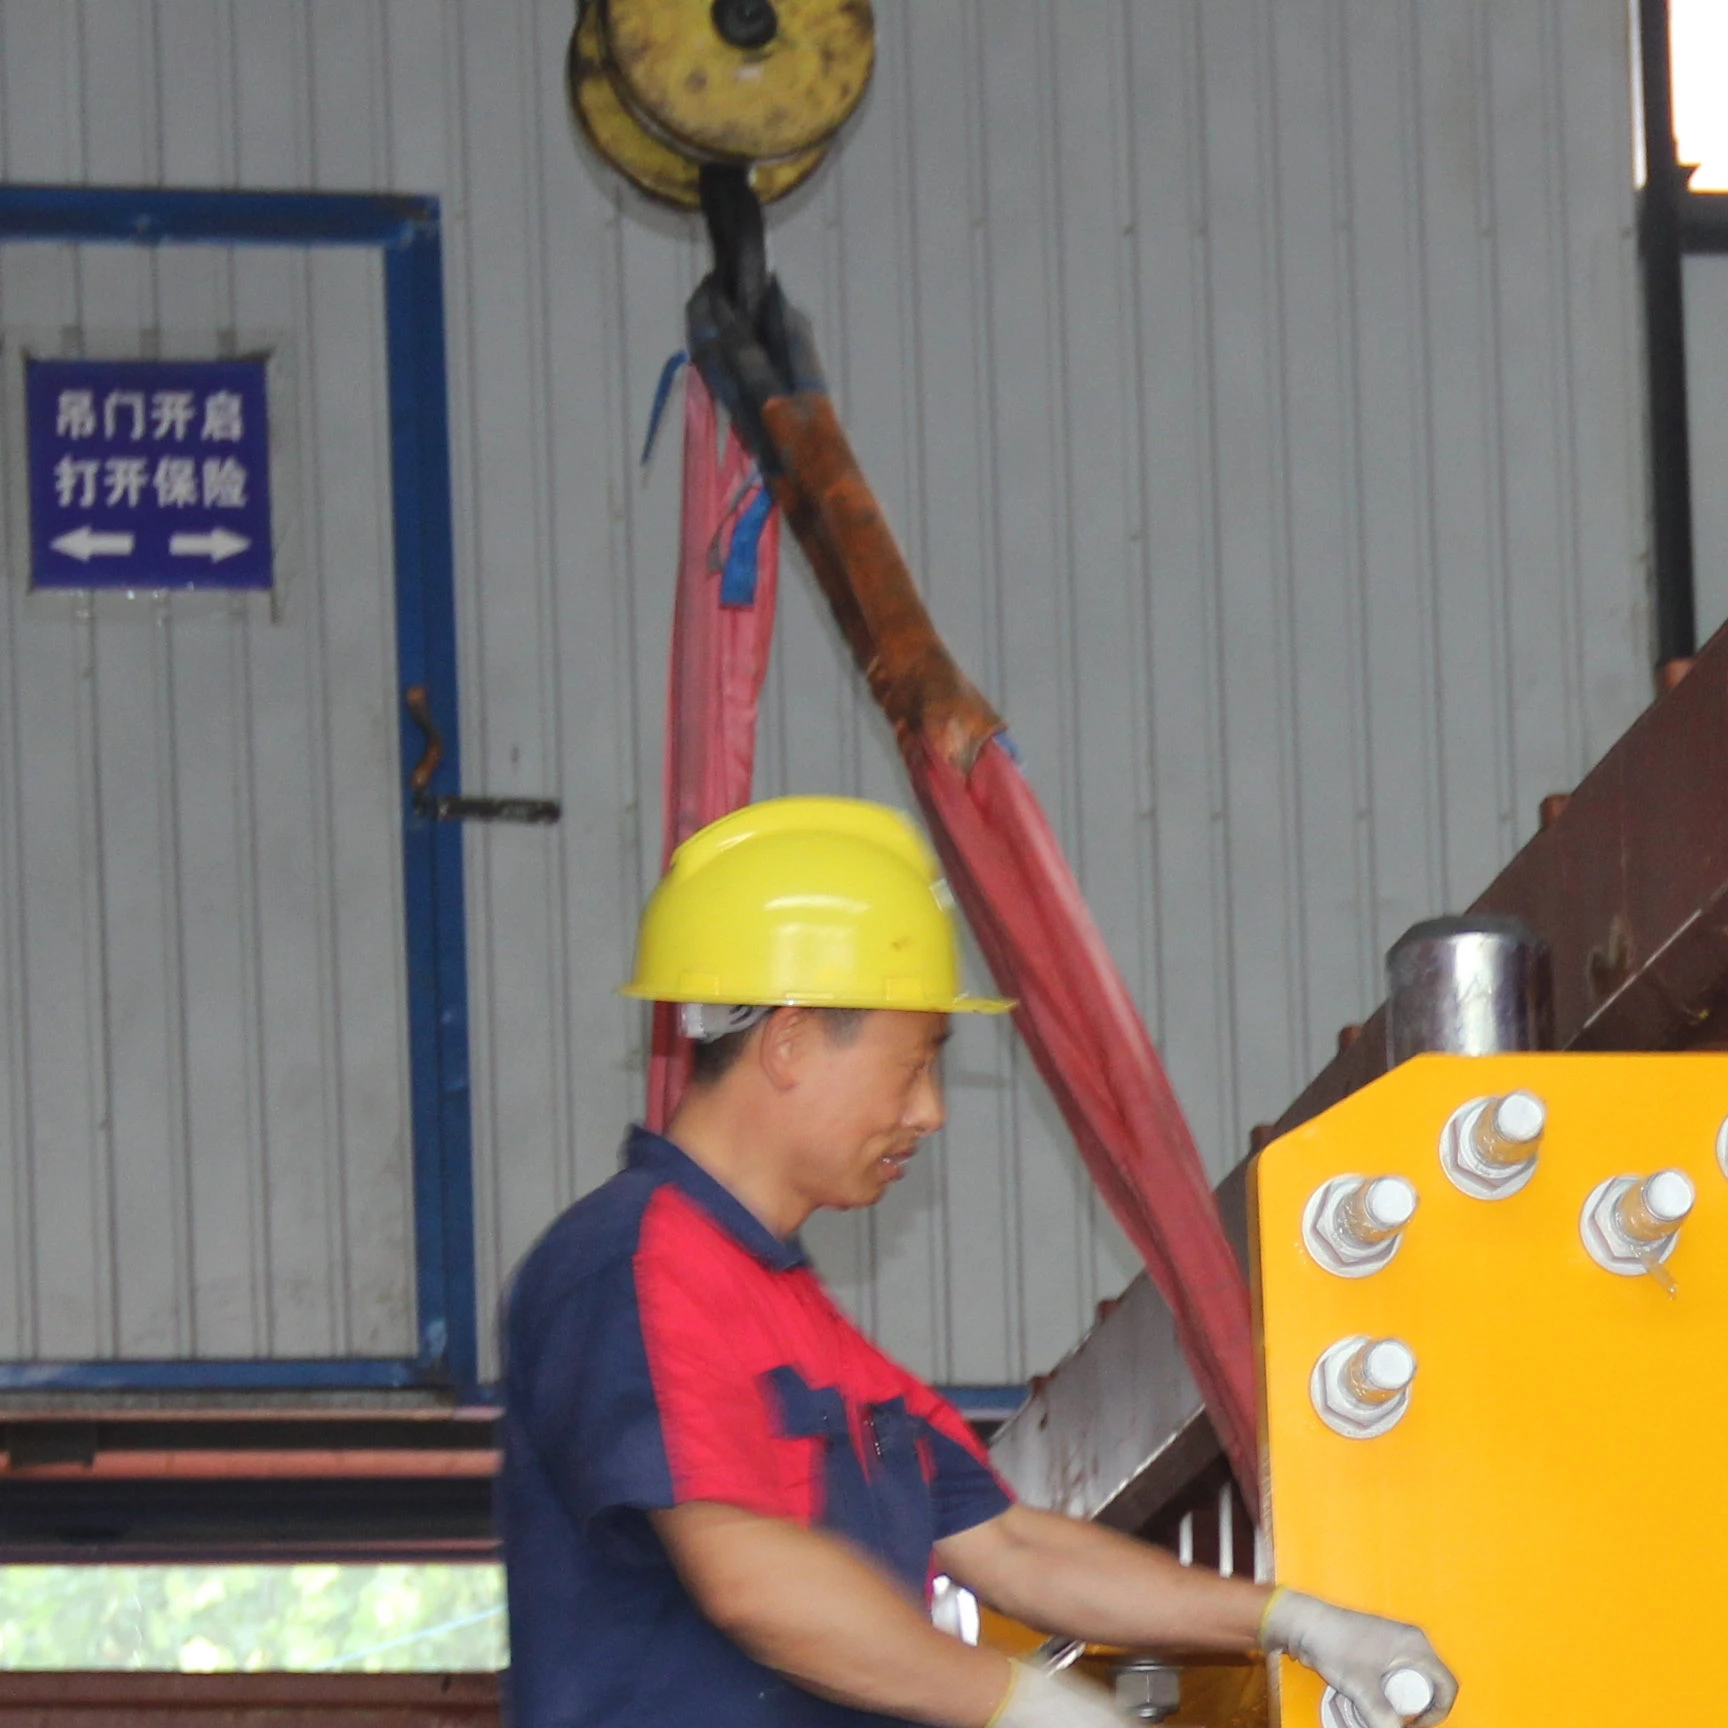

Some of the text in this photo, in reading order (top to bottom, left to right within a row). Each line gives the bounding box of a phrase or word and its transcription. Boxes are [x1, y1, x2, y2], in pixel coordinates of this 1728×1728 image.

[56, 389, 244, 442] 吊门开启
[53, 452, 248, 509] 打开保险
